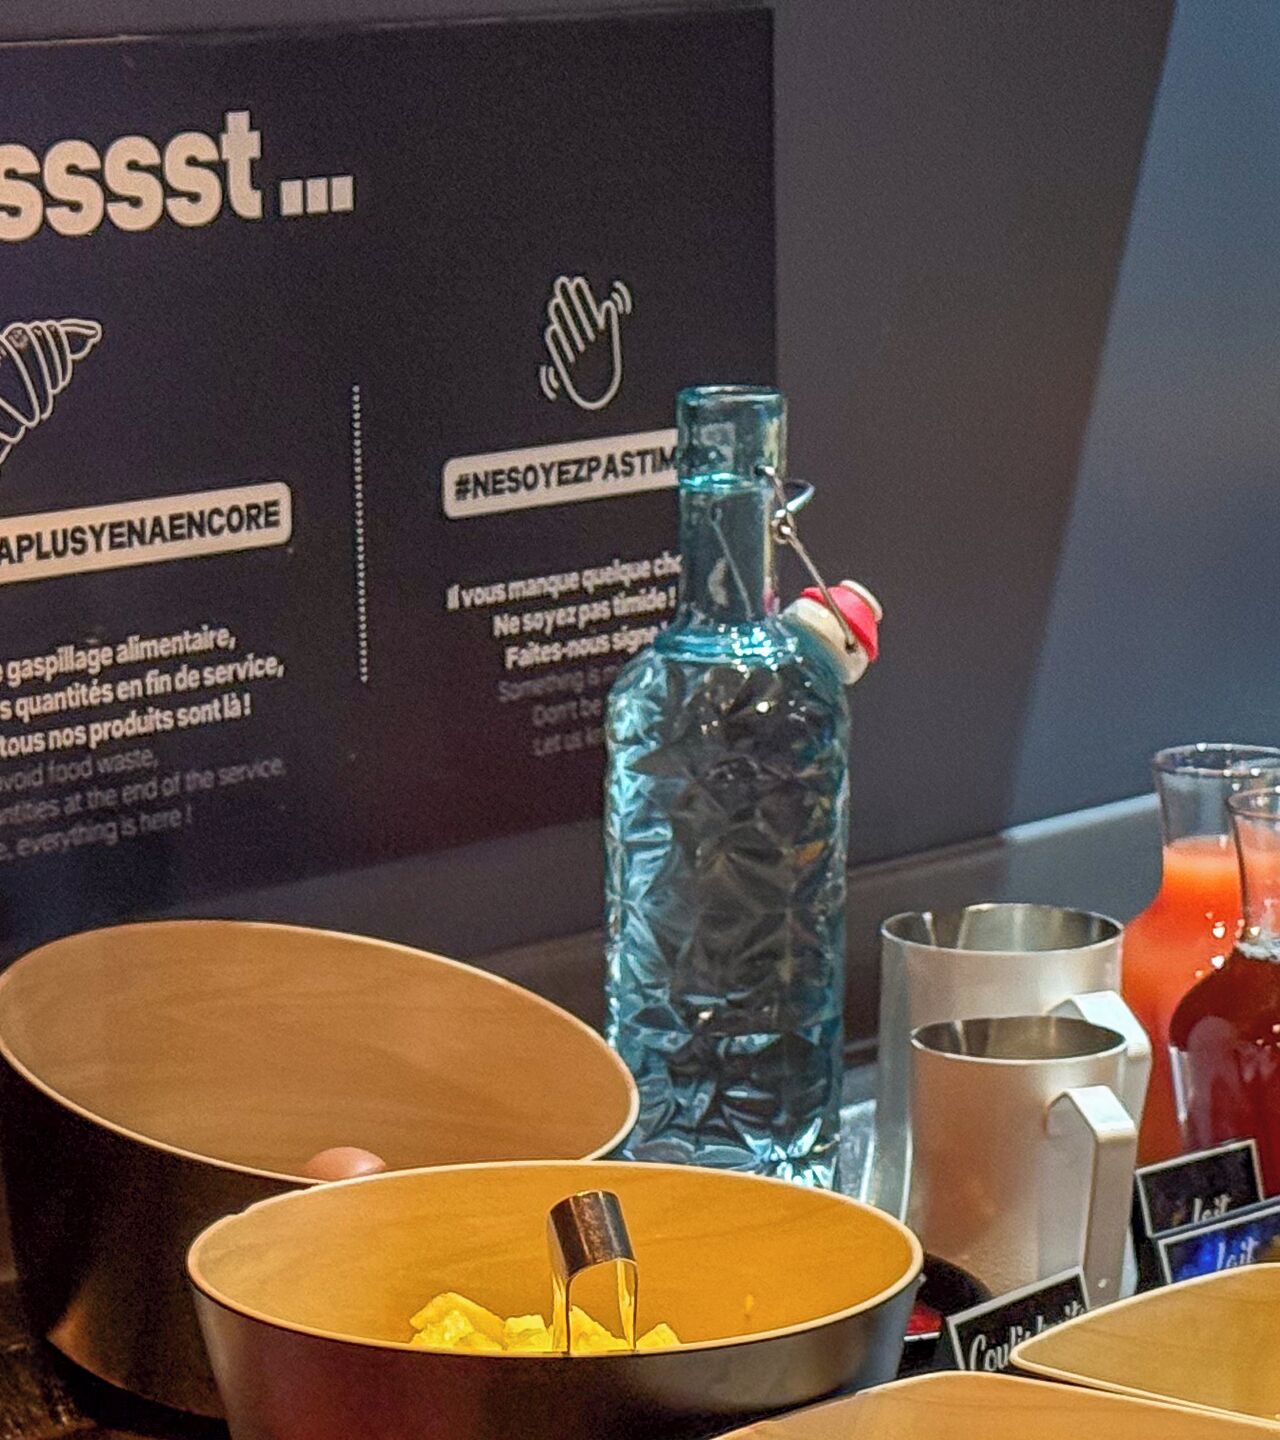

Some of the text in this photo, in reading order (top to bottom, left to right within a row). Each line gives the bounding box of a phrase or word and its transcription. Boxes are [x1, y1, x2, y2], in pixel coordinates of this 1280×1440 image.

[462, 582, 507, 608] vous
[508, 571, 580, 600] manque
[582, 558, 652, 594] quelque
[493, 613, 520, 638] Ne
[522, 605, 577, 636] soyez
[579, 599, 612, 631] pas
[613, 586, 667, 617] timide
[7, 645, 114, 688] gaspillage
[116, 624, 237, 665] alimentaire,
[505, 633, 611, 670] Faites-nous
[15, 678, 114, 724] quantités
[116, 677, 143, 701] en
[145, 668, 172, 696] fin
[174, 663, 200, 692] de
[202, 652, 285, 687] service,
[48, 724, 86, 750] nos
[89, 706, 174, 749] produits
[176, 698, 221, 728] sont
[223, 692, 242, 719] là
